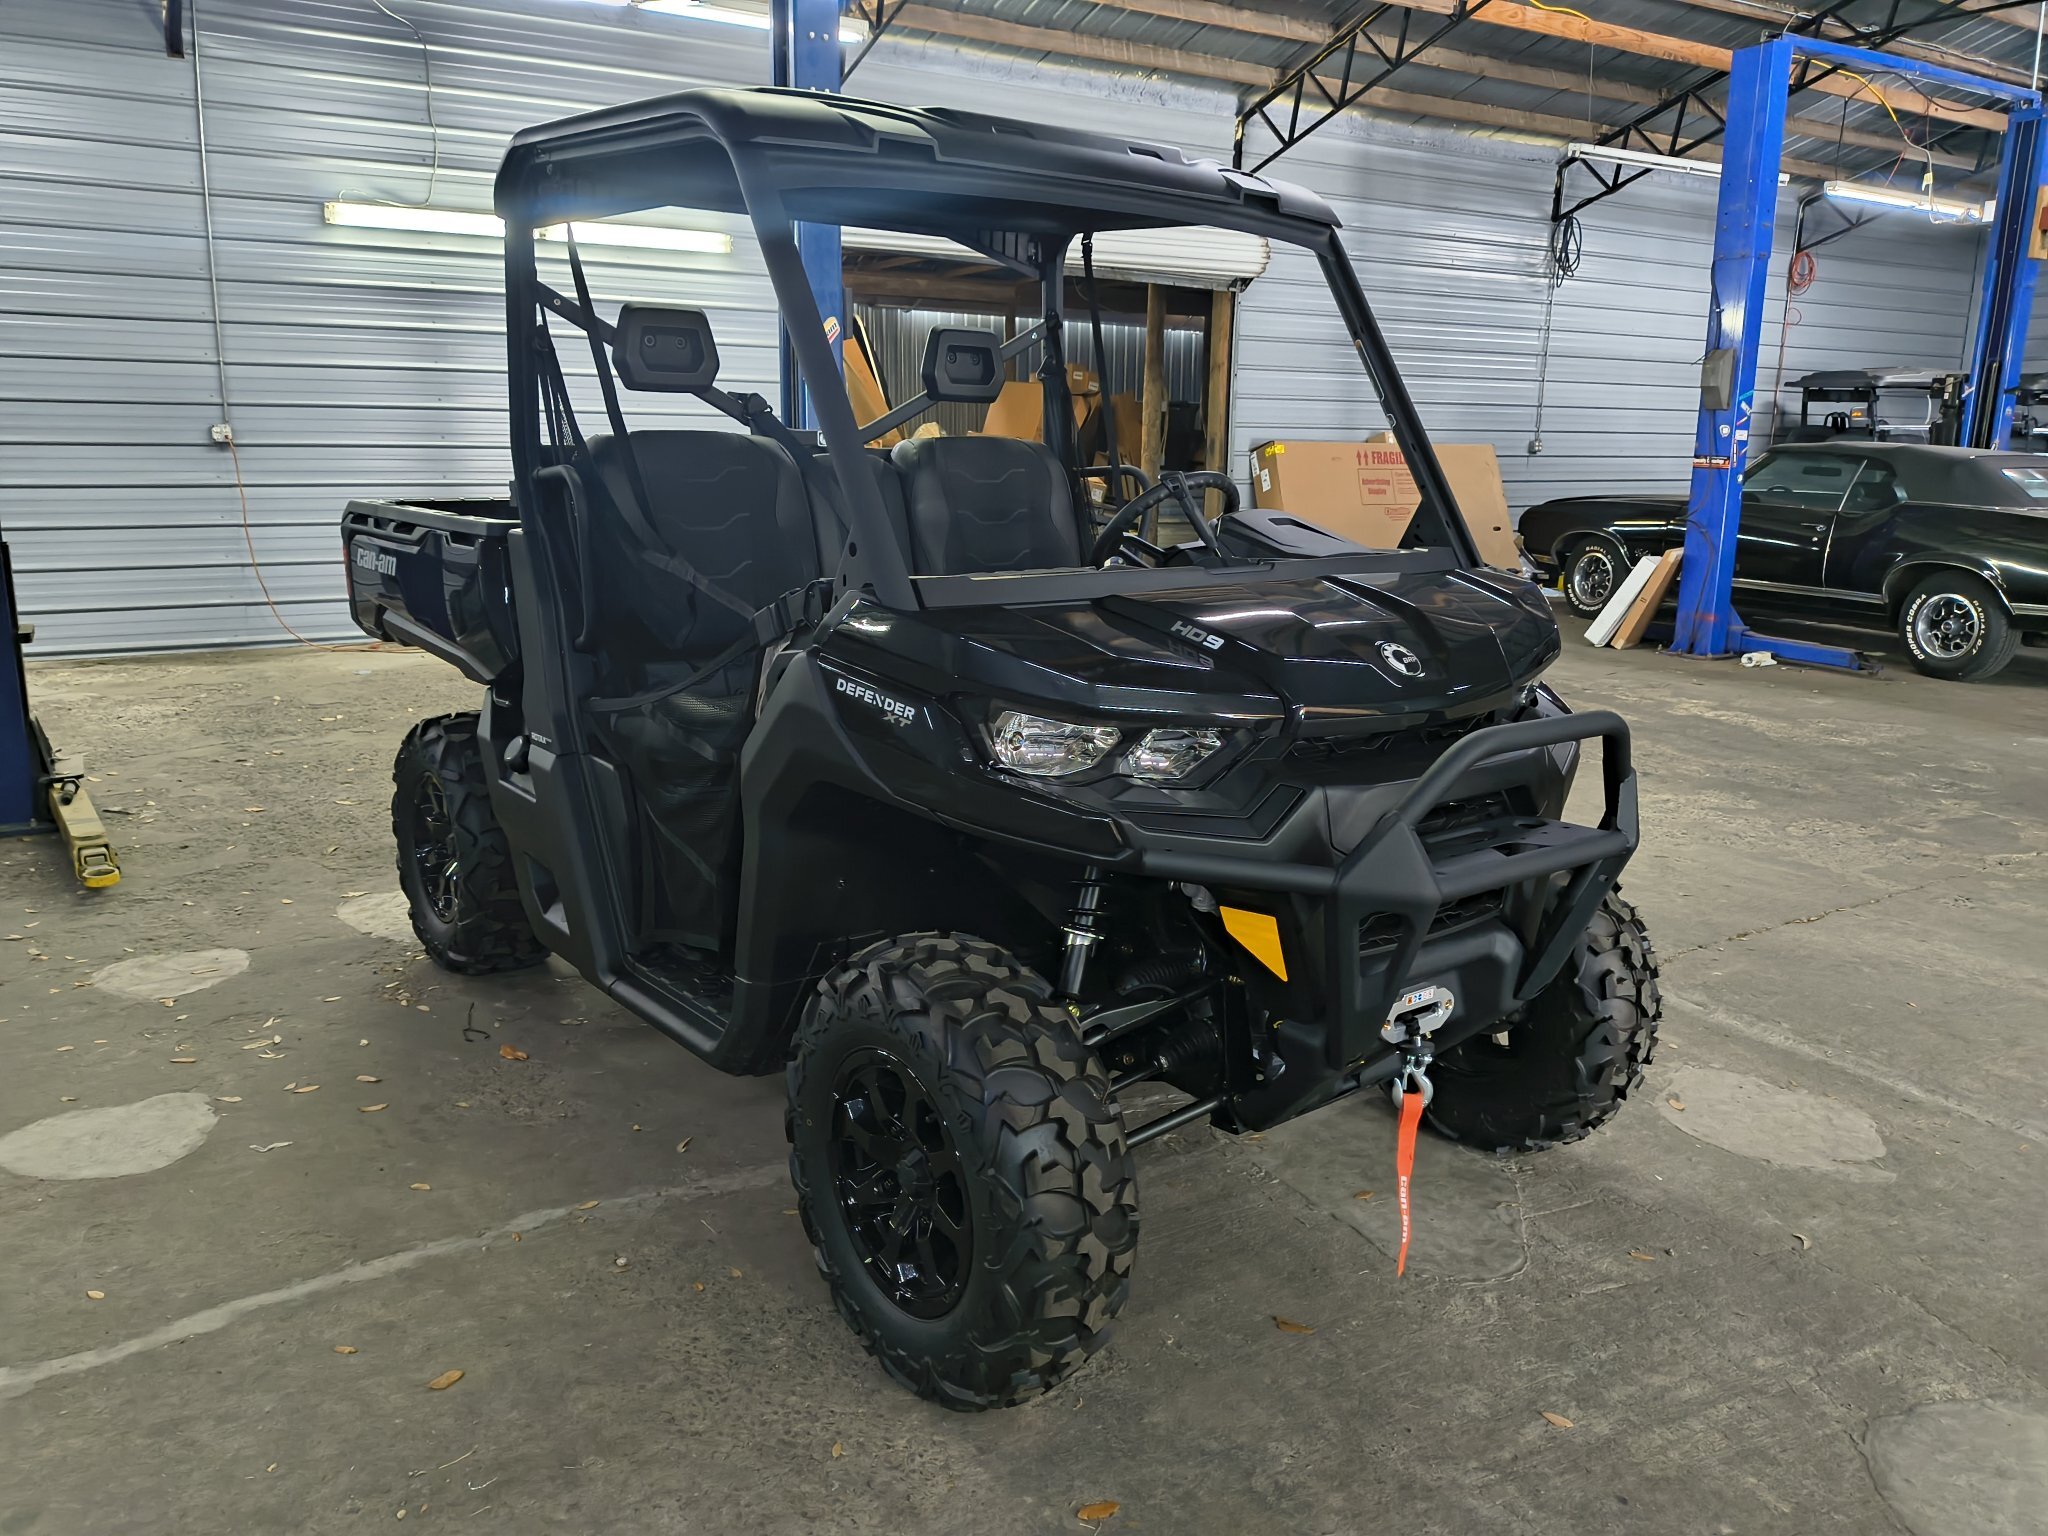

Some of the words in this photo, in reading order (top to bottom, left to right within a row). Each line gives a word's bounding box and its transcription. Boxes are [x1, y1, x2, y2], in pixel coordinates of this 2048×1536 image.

[1371, 451, 1406, 465] FRAGIL
[357, 548, 396, 576] can-am
[1907, 594, 1927, 623] COBRA
[1972, 600, 1986, 636] RADIAL
[1170, 620, 1225, 650] HD9
[1402, 656, 1416, 664] BRP
[836, 678, 915, 720] DEFENDER
[882, 711, 912, 727] XT
